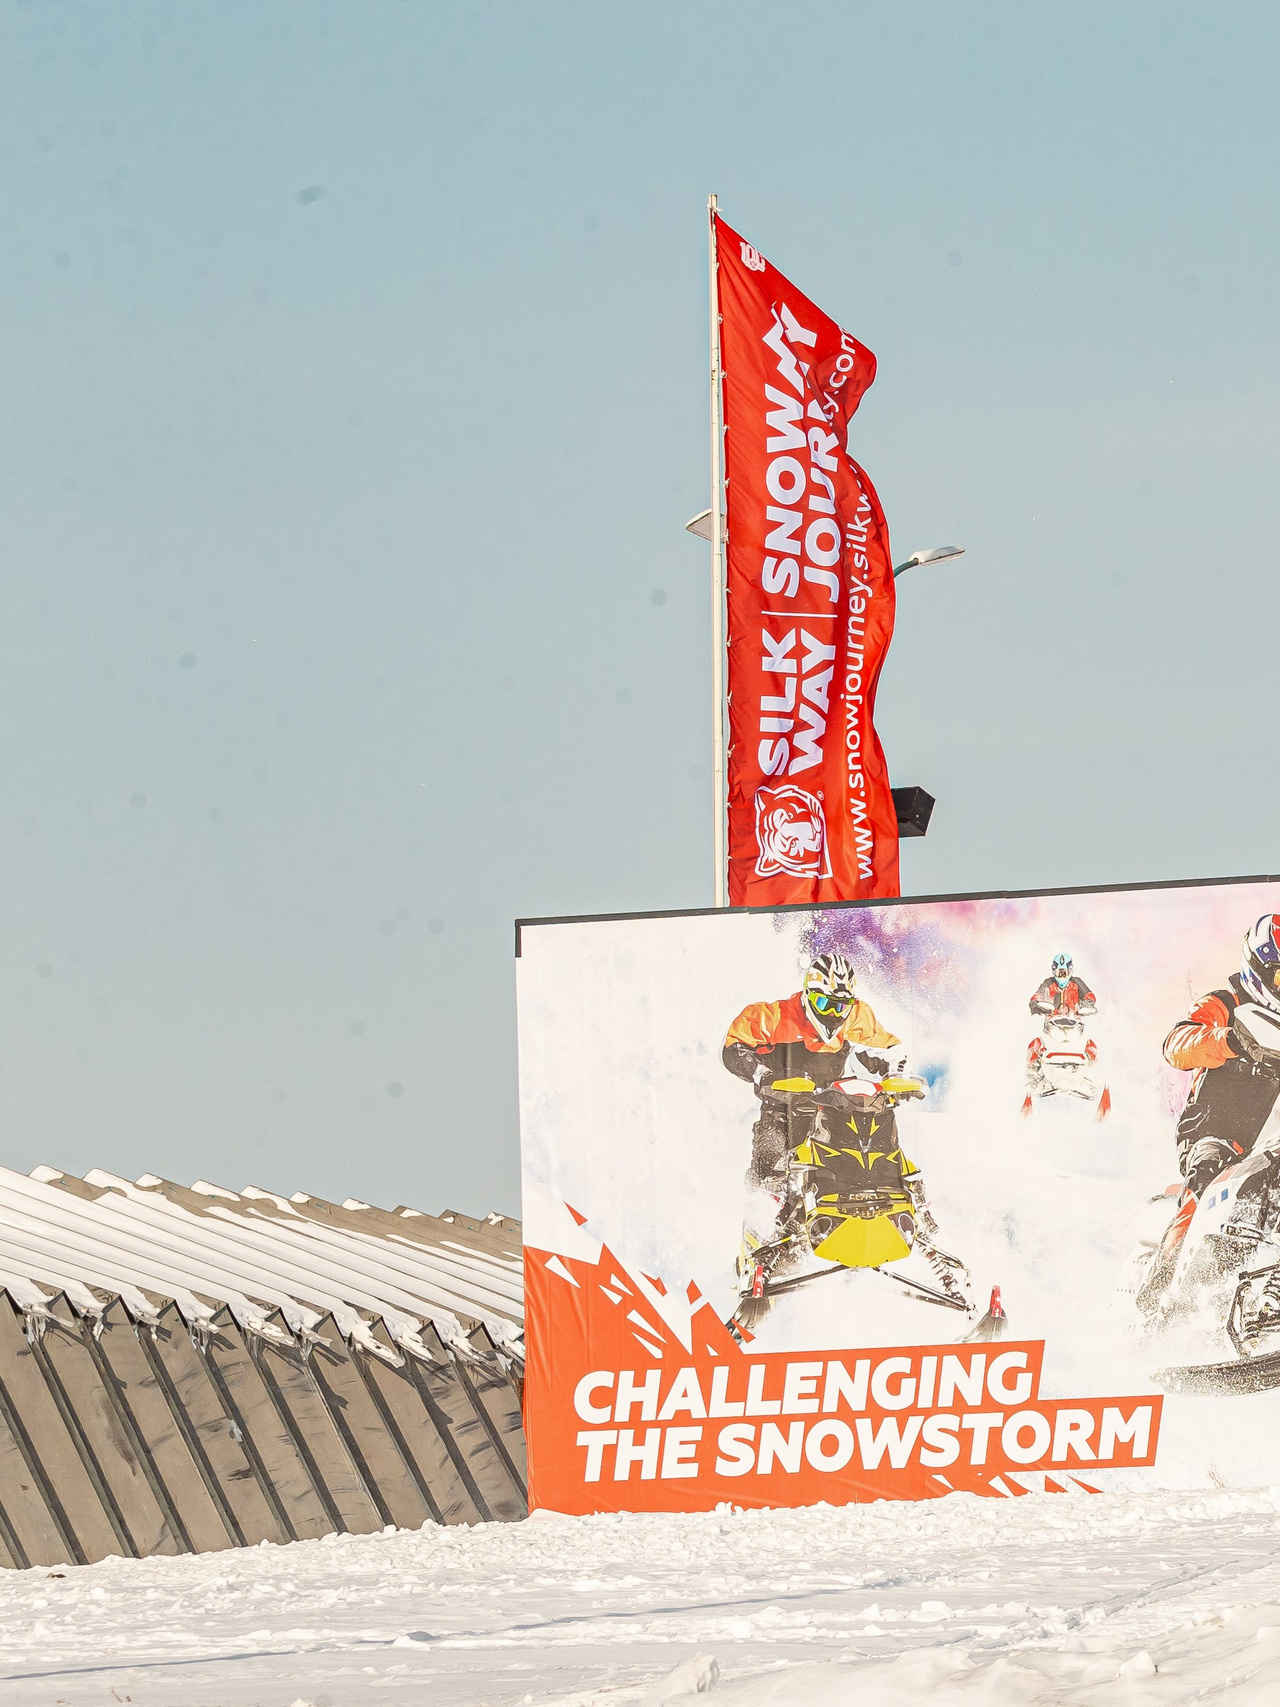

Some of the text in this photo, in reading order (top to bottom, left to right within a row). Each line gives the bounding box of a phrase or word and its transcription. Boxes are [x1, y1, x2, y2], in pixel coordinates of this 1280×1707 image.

[757, 383, 808, 777] SILK SNOW
[788, 627, 836, 777] WAY
[572, 1351, 1032, 1425] CHALLENGING
[576, 1405, 1153, 1483] THE SNOWSTORM
